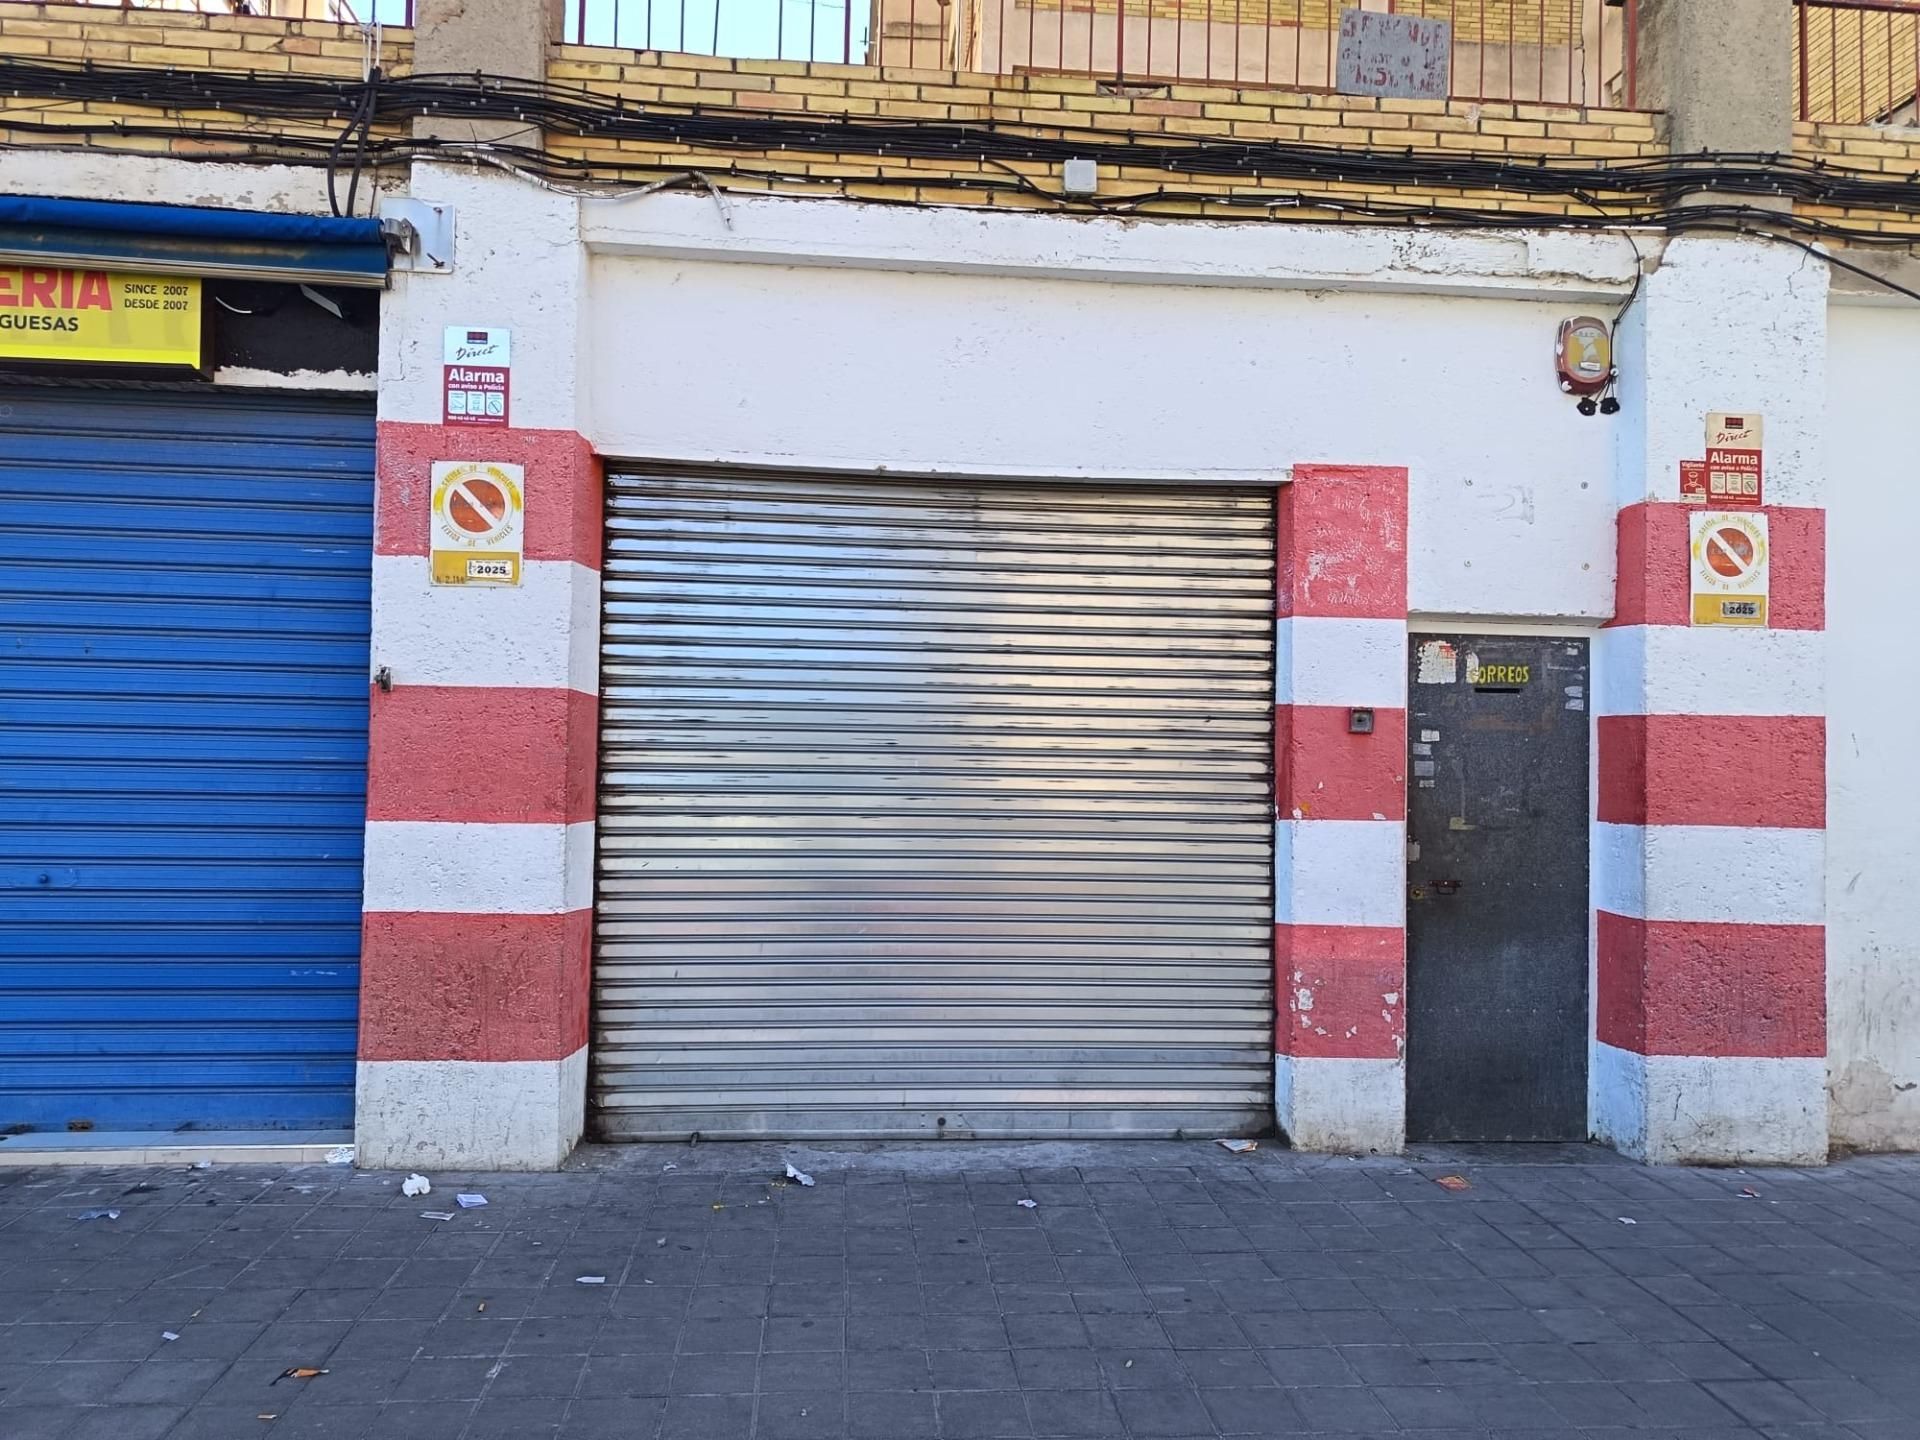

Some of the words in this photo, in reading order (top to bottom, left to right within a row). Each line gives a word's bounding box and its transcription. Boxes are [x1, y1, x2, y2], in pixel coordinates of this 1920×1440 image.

[124, 283, 158, 295] SINCE
[163, 285, 189, 296] 2007
[124, 298, 160, 309] DESDE
[163, 299, 189, 310] 2007
[0, 313, 79, 332] GUESAS
[456, 344, 499, 361] Direct
[448, 367, 505, 384] Alarma
[1716, 429, 1753, 444] Direct
[1710, 450, 1758, 465] Alarma
[476, 565, 507, 574] 2025
[1729, 605, 1755, 615] 2025
